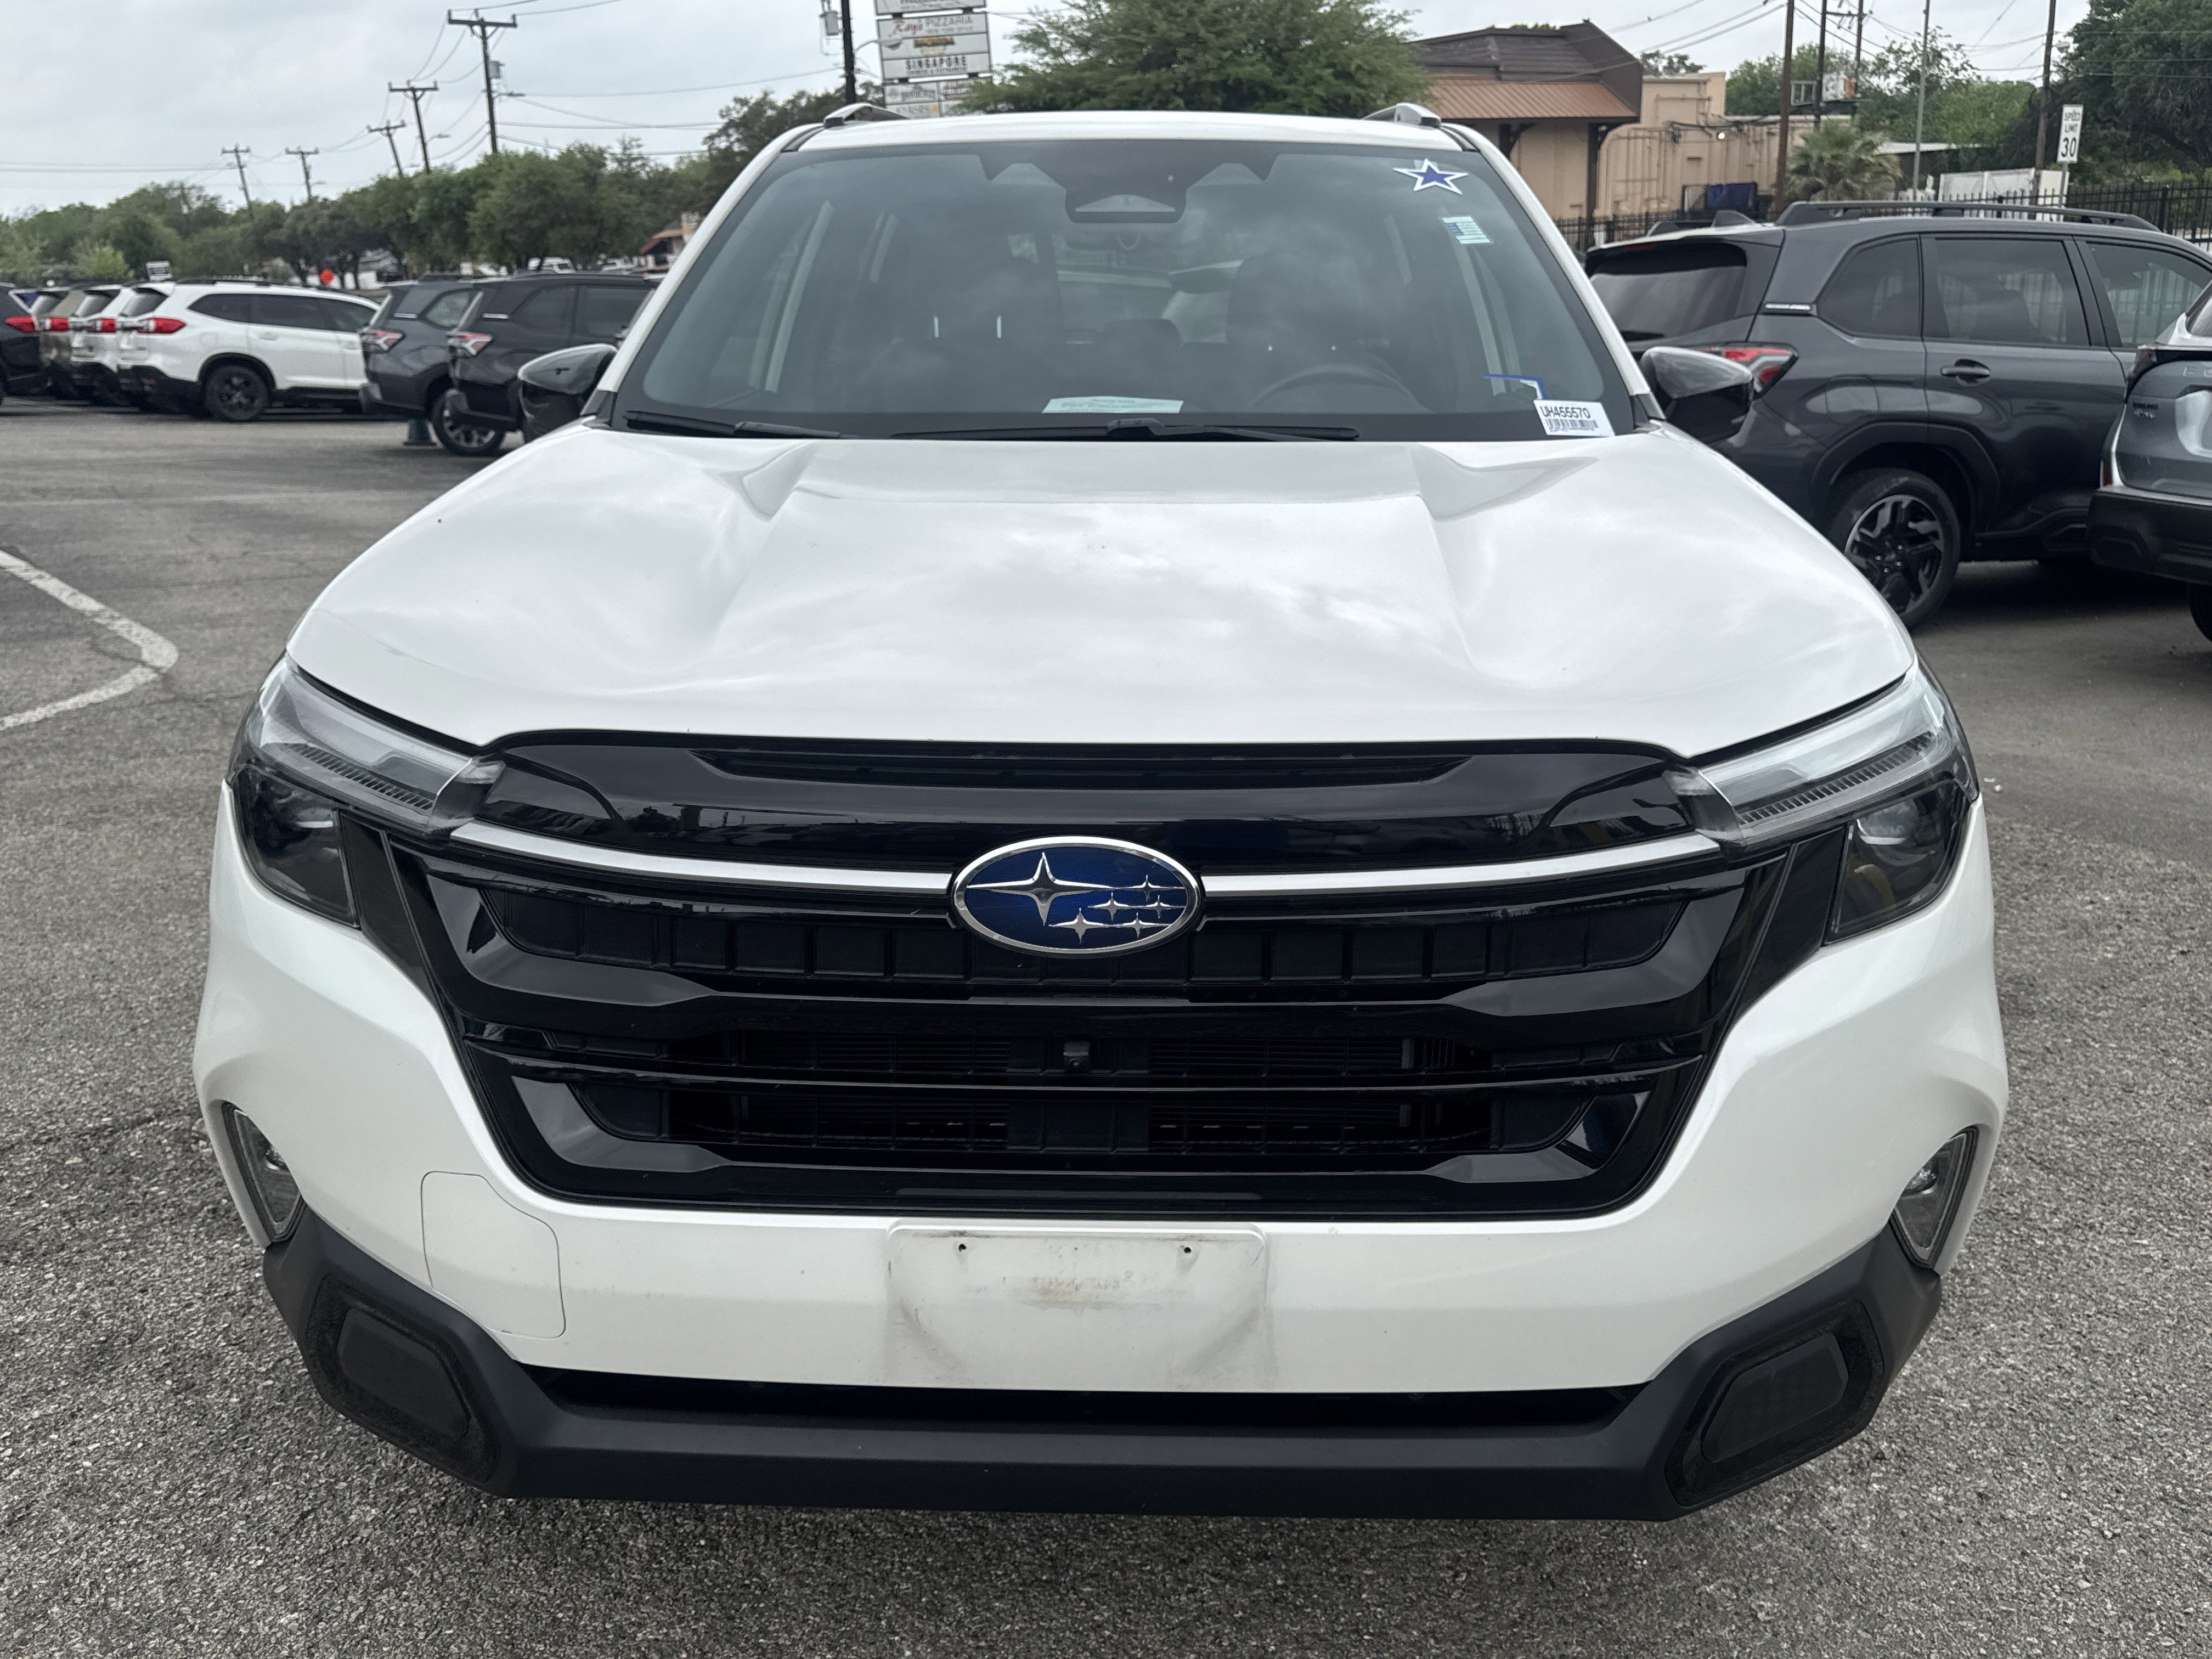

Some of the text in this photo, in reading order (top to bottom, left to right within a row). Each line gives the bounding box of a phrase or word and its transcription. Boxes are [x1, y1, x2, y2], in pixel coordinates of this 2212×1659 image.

[906, 56, 967, 70] SINGAPORE
[2064, 111, 2080, 121] SPEED
[2064, 123, 2078, 133] LIMIT
[2061, 136, 2076, 157] 30
[1540, 406, 1590, 419] UH455570
